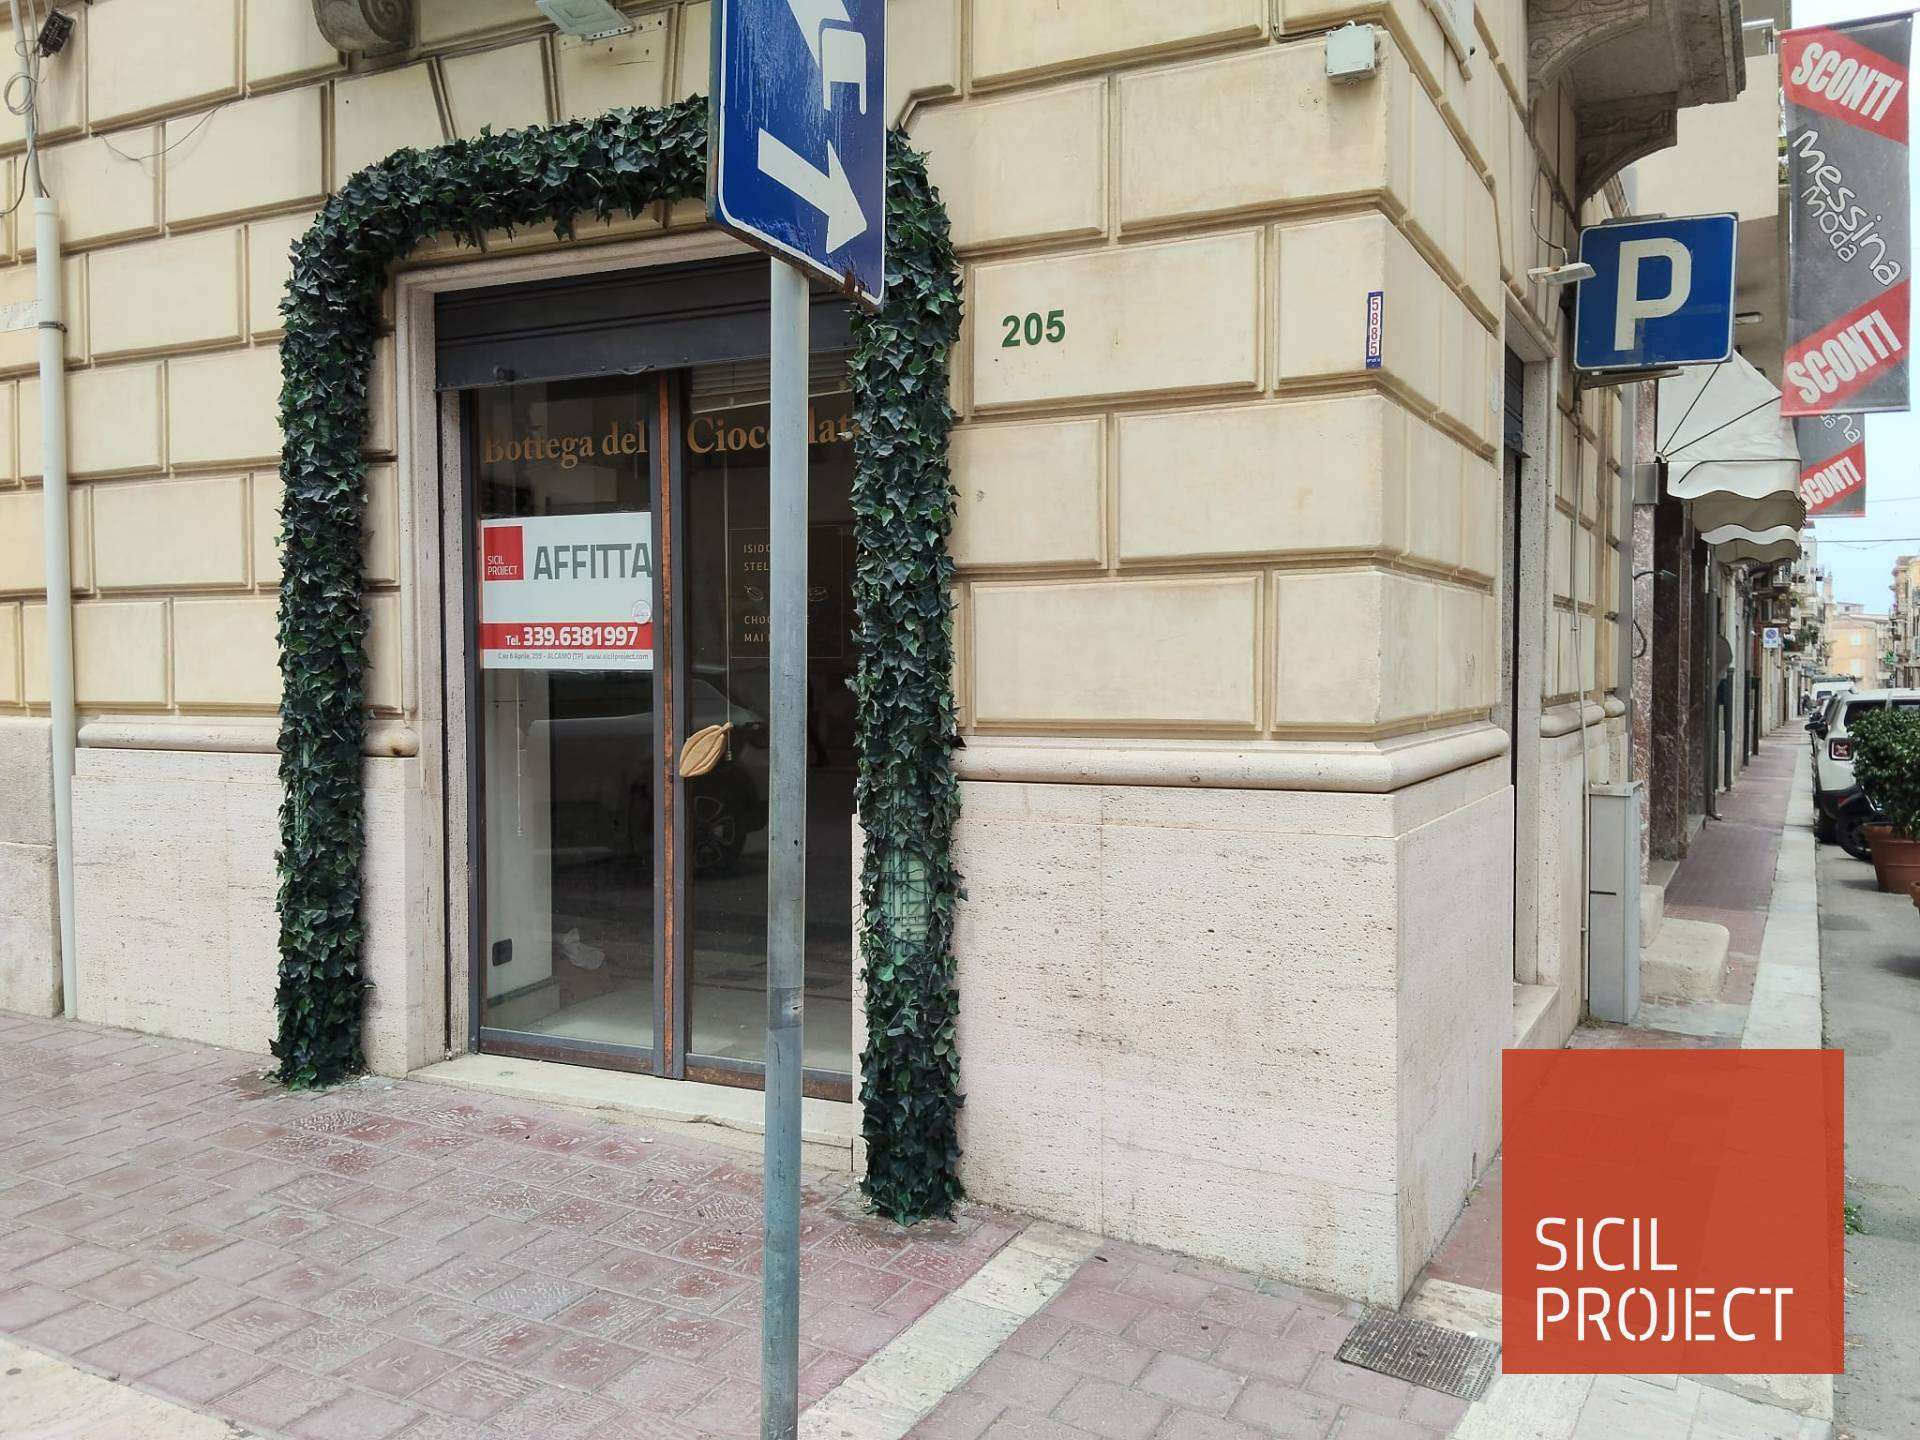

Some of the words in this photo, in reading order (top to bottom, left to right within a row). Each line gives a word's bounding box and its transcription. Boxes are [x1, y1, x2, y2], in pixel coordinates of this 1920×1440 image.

[1791, 42, 1904, 122] SCONTI
[1614, 237, 1692, 351] P
[1001, 309, 1066, 348] 205
[1370, 297, 1379, 356] 5885
[1786, 309, 1903, 404] SCONTI
[483, 431, 596, 470] Bottega
[601, 419, 649, 456] del
[487, 554, 505, 565] SICIL
[487, 565, 518, 576] PROJECT
[533, 542, 653, 581] AFFITTA
[743, 561, 770, 571] STEL
[504, 635, 522, 646] Tel.
[522, 626, 639, 646] 339.6381997
